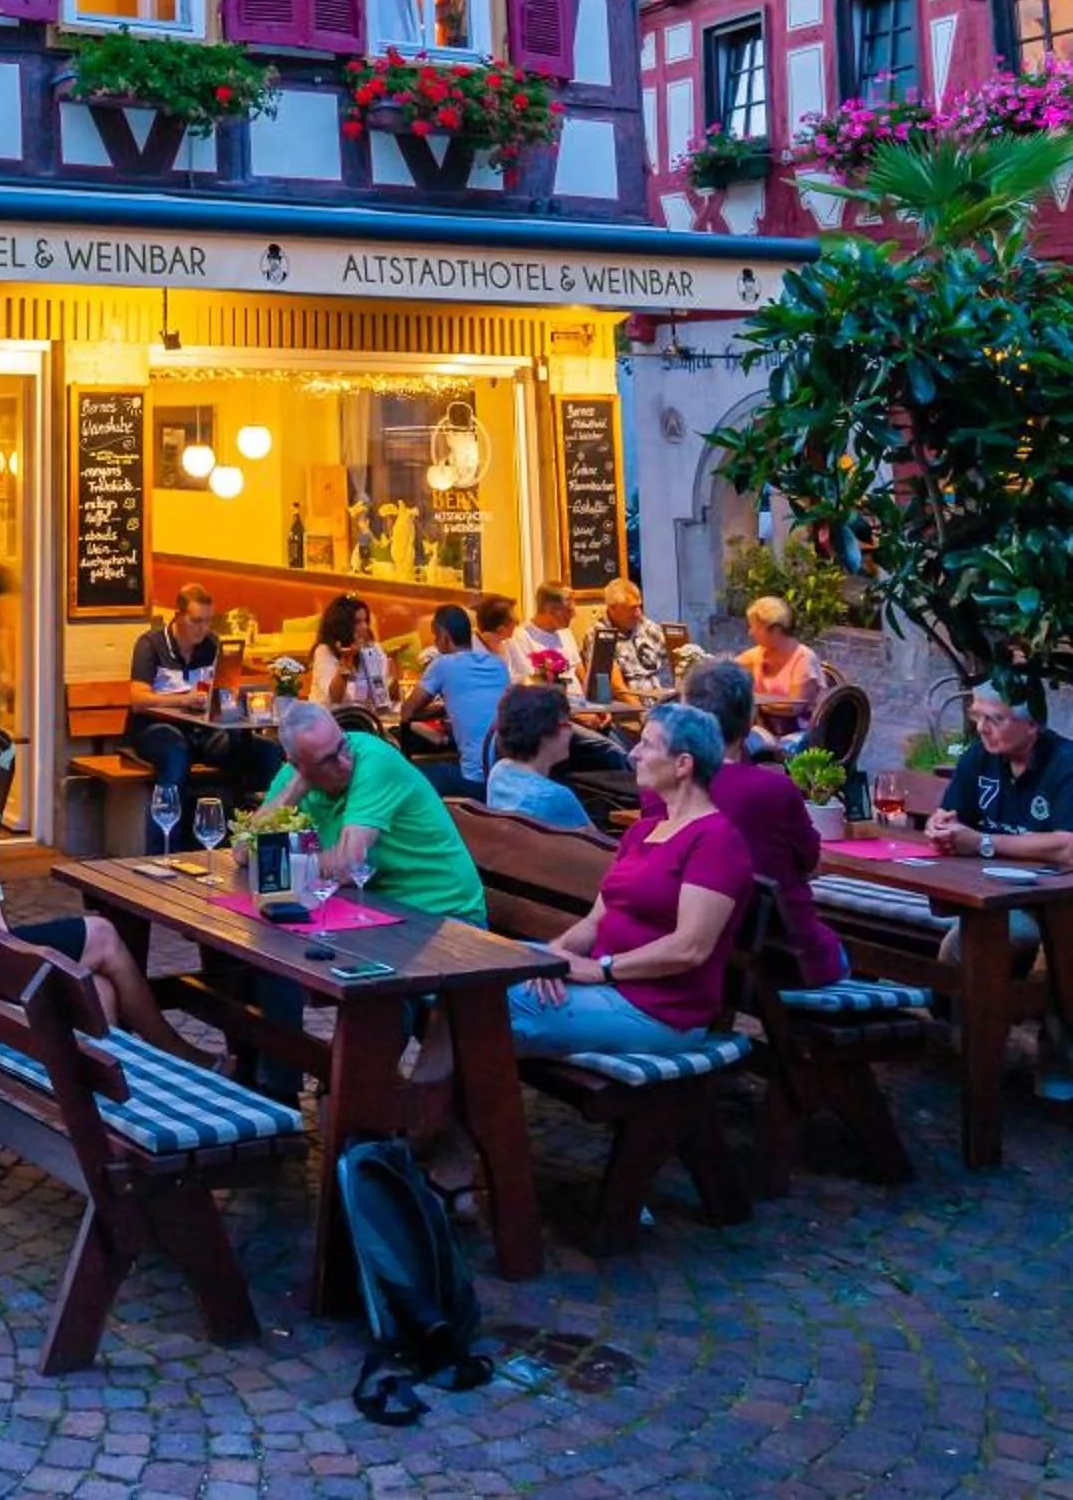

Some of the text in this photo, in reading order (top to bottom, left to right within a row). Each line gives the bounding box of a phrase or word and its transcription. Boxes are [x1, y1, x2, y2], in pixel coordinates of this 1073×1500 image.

[34, 238, 54, 269] &
[64, 240, 207, 277] WEINBAR
[342, 254, 694, 297] ALTSTADTHOTEL & WEINBAR
[978, 775, 1000, 811] 7
